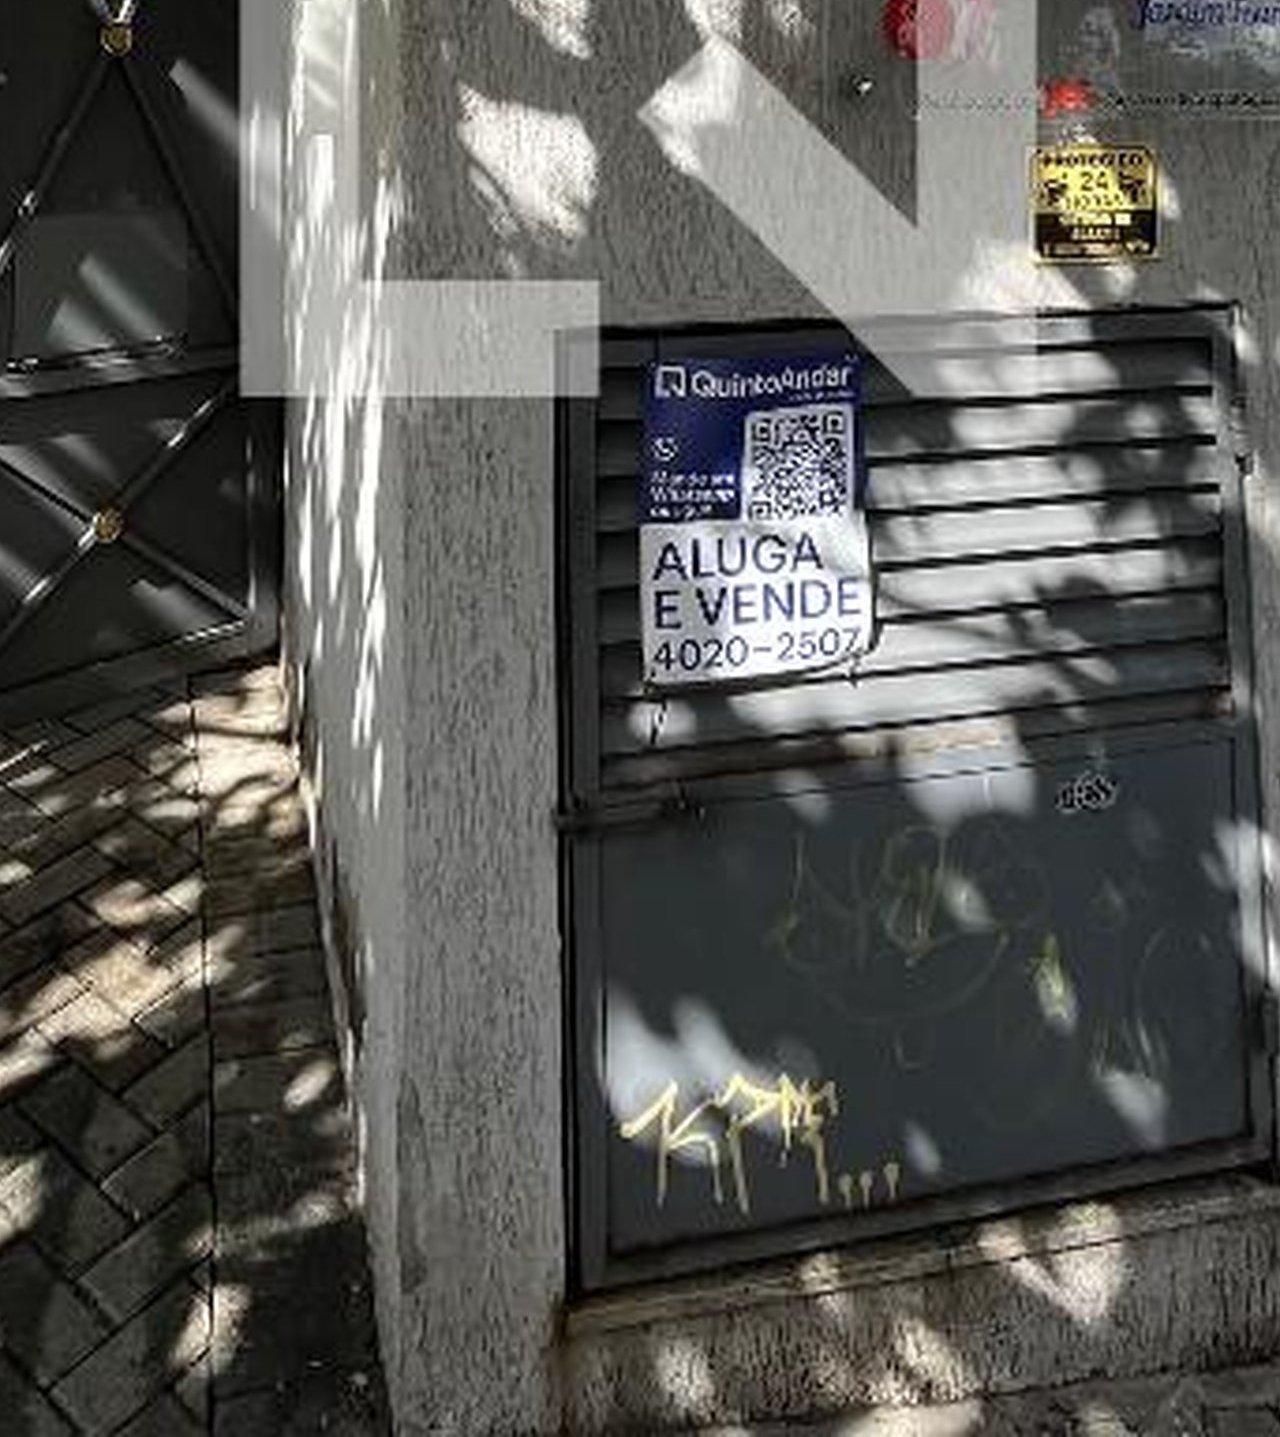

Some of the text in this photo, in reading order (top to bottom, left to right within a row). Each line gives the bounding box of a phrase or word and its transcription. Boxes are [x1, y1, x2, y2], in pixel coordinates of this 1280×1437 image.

[1080, 170, 1109, 192] 24
[690, 364, 853, 398] QuintoAndar
[652, 532, 824, 581] ALUGA
[653, 576, 863, 630] E VENDE
[653, 627, 862, 671] 4020-2507
